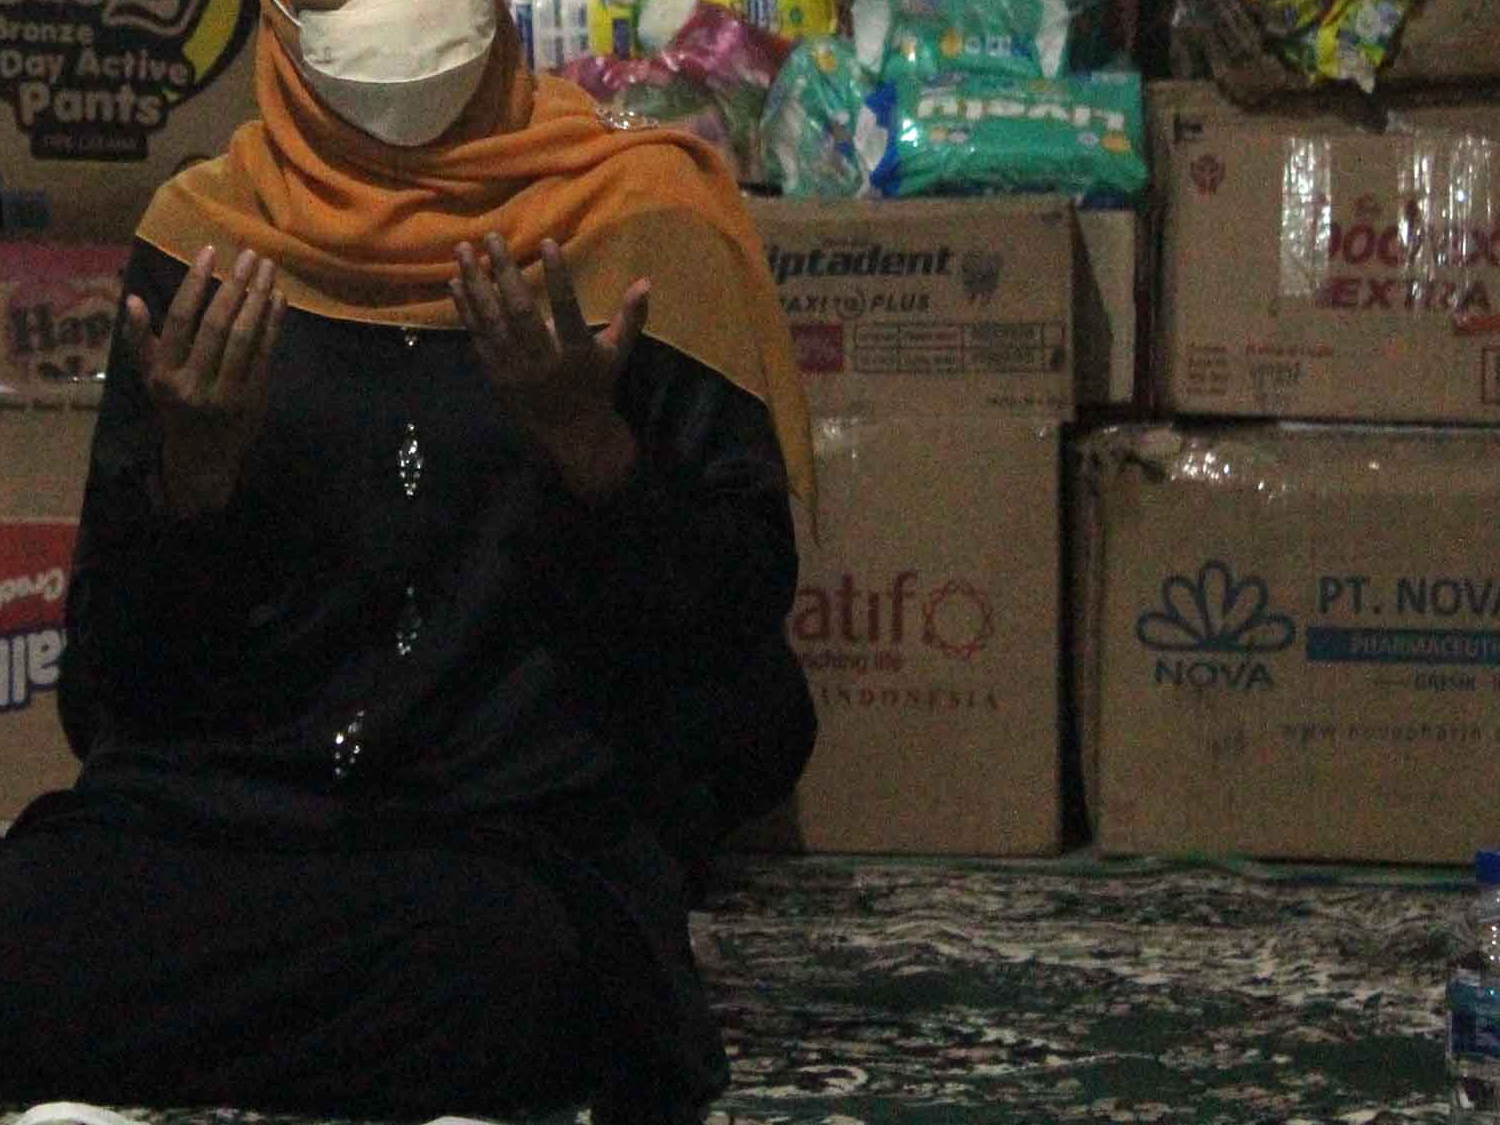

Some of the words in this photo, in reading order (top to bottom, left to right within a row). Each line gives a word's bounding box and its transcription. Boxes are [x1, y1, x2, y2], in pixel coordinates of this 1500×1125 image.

[0, 48, 64, 84] Day
[76, 46, 191, 85] Active
[16, 81, 164, 127] Pants
[764, 242, 956, 285] iptadent
[792, 568, 918, 642] atif
[1318, 575, 1381, 616] PT.
[1154, 657, 1274, 691] NOVA
